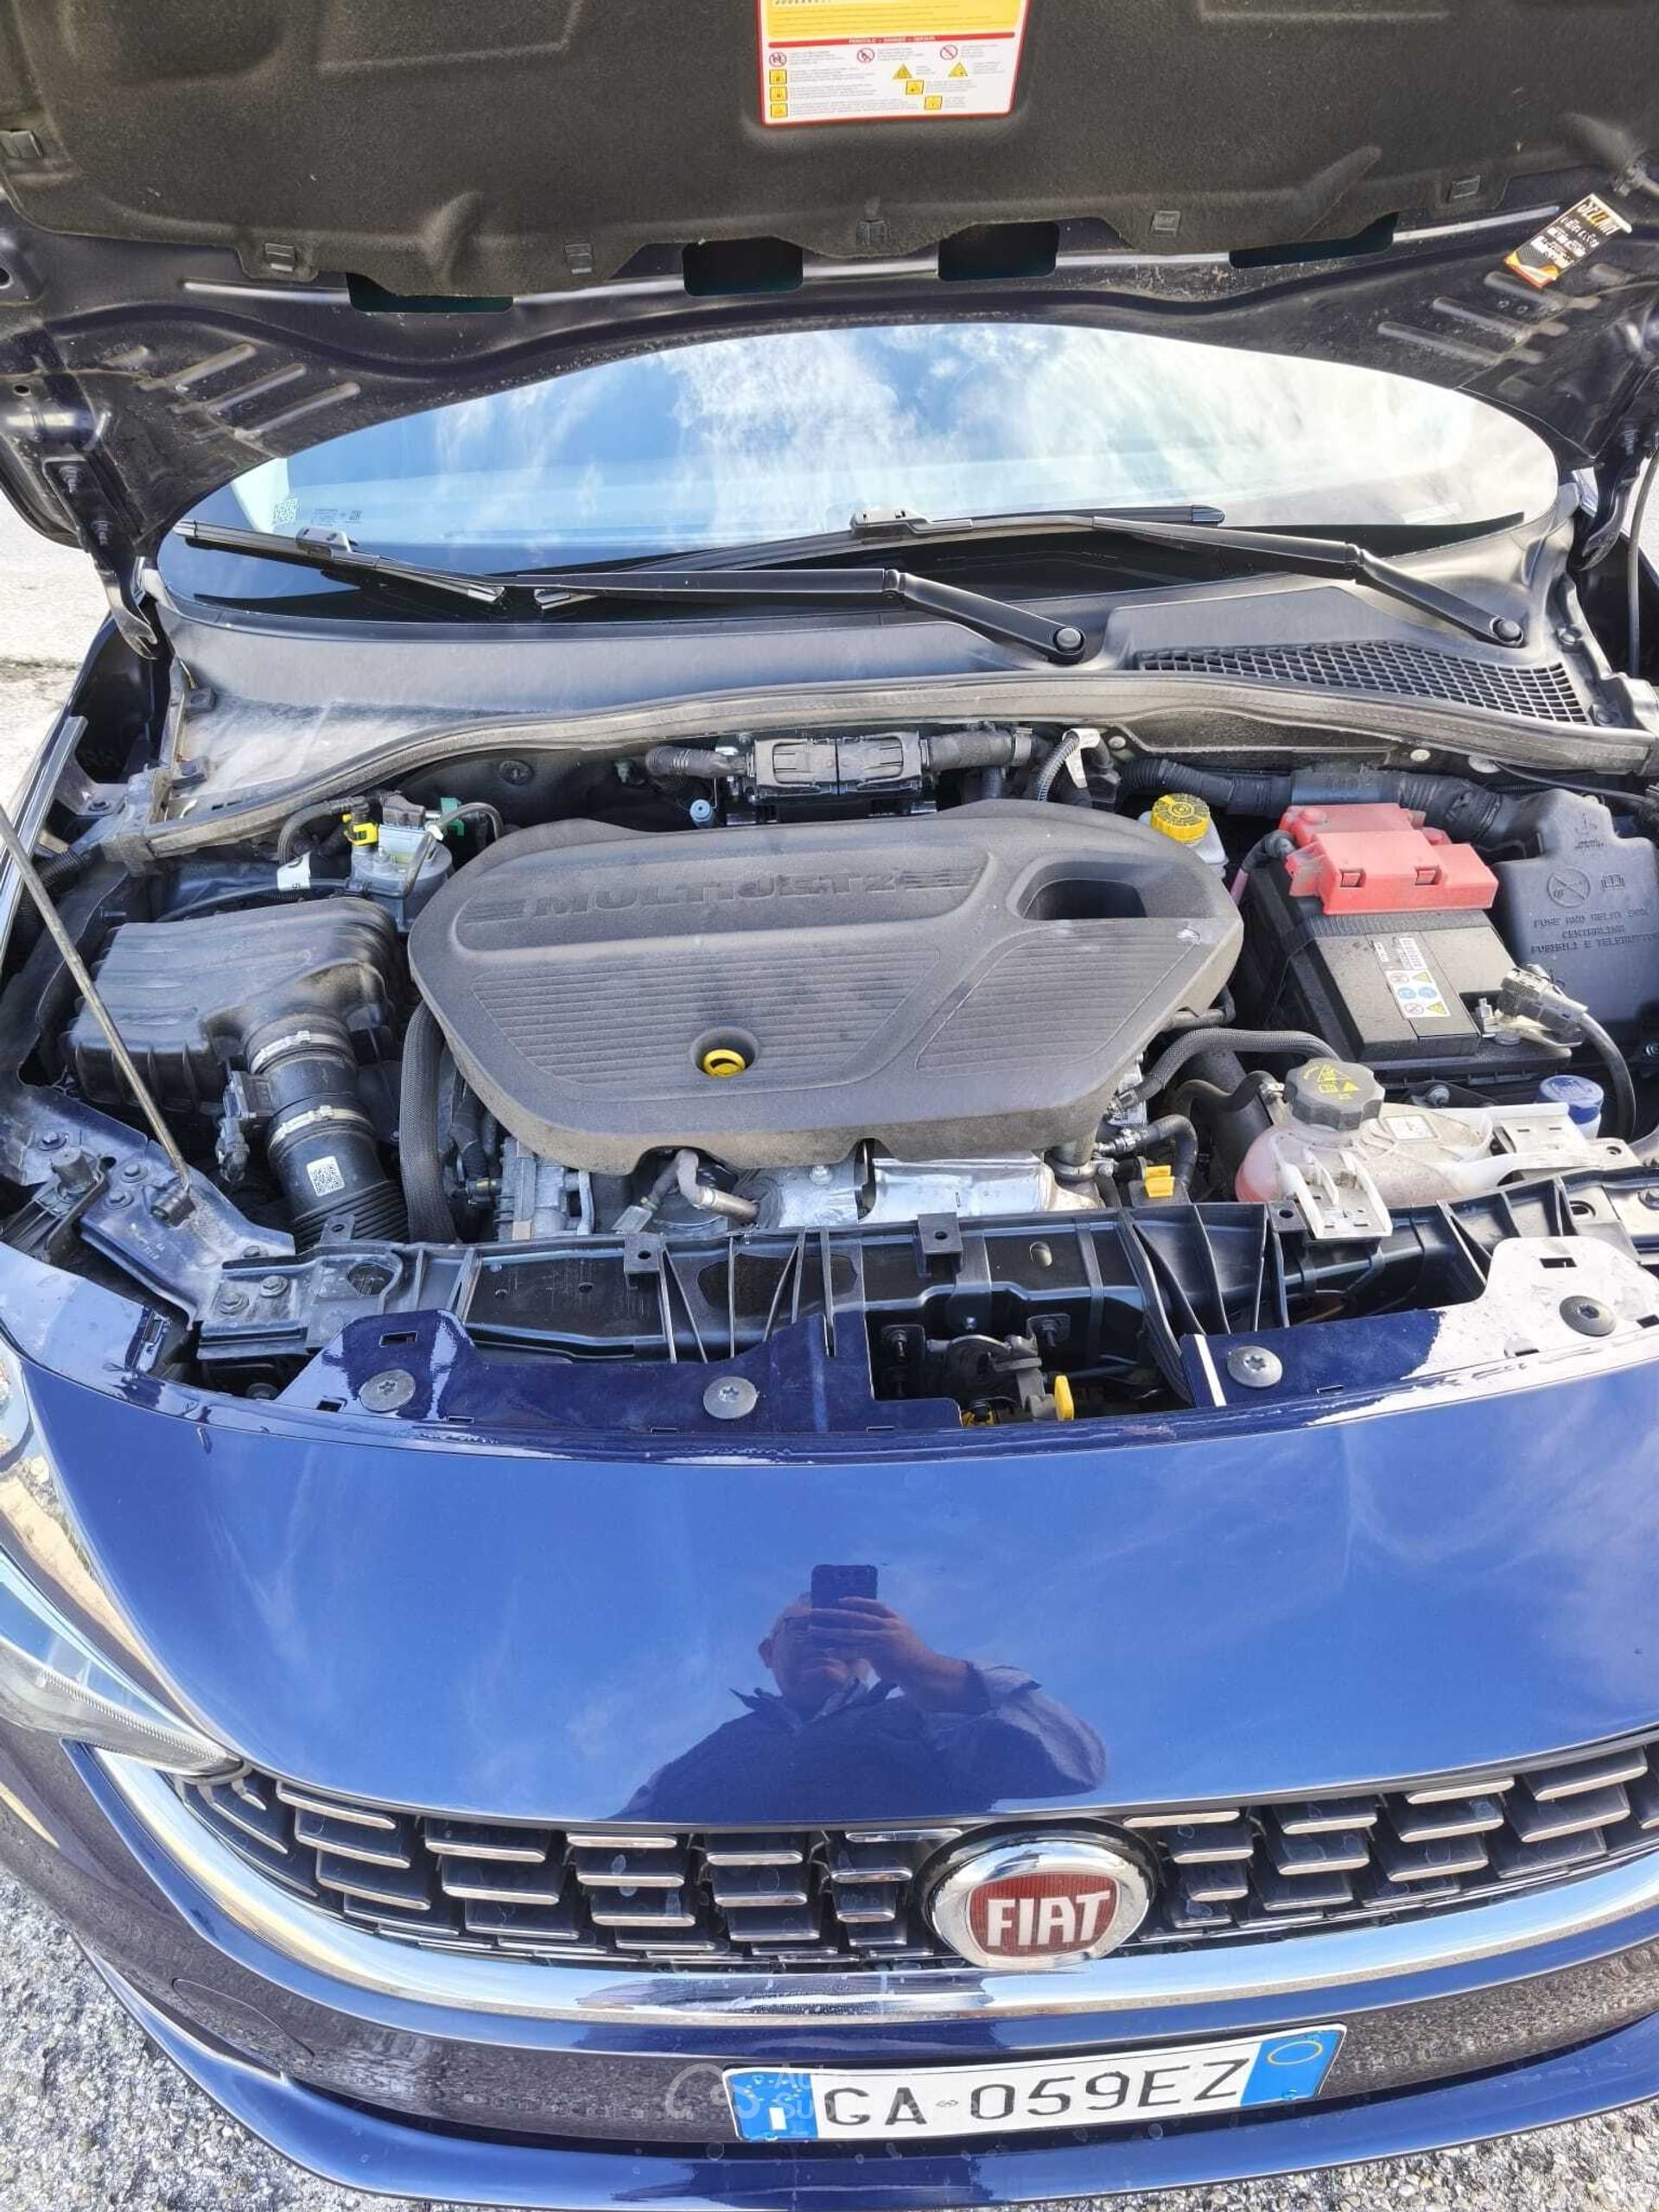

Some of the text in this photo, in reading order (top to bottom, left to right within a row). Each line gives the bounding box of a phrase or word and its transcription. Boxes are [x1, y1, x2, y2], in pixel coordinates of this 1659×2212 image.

[987, 1890, 1110, 1947] FIAT
[823, 2055, 1251, 2126] GA 059EZ
